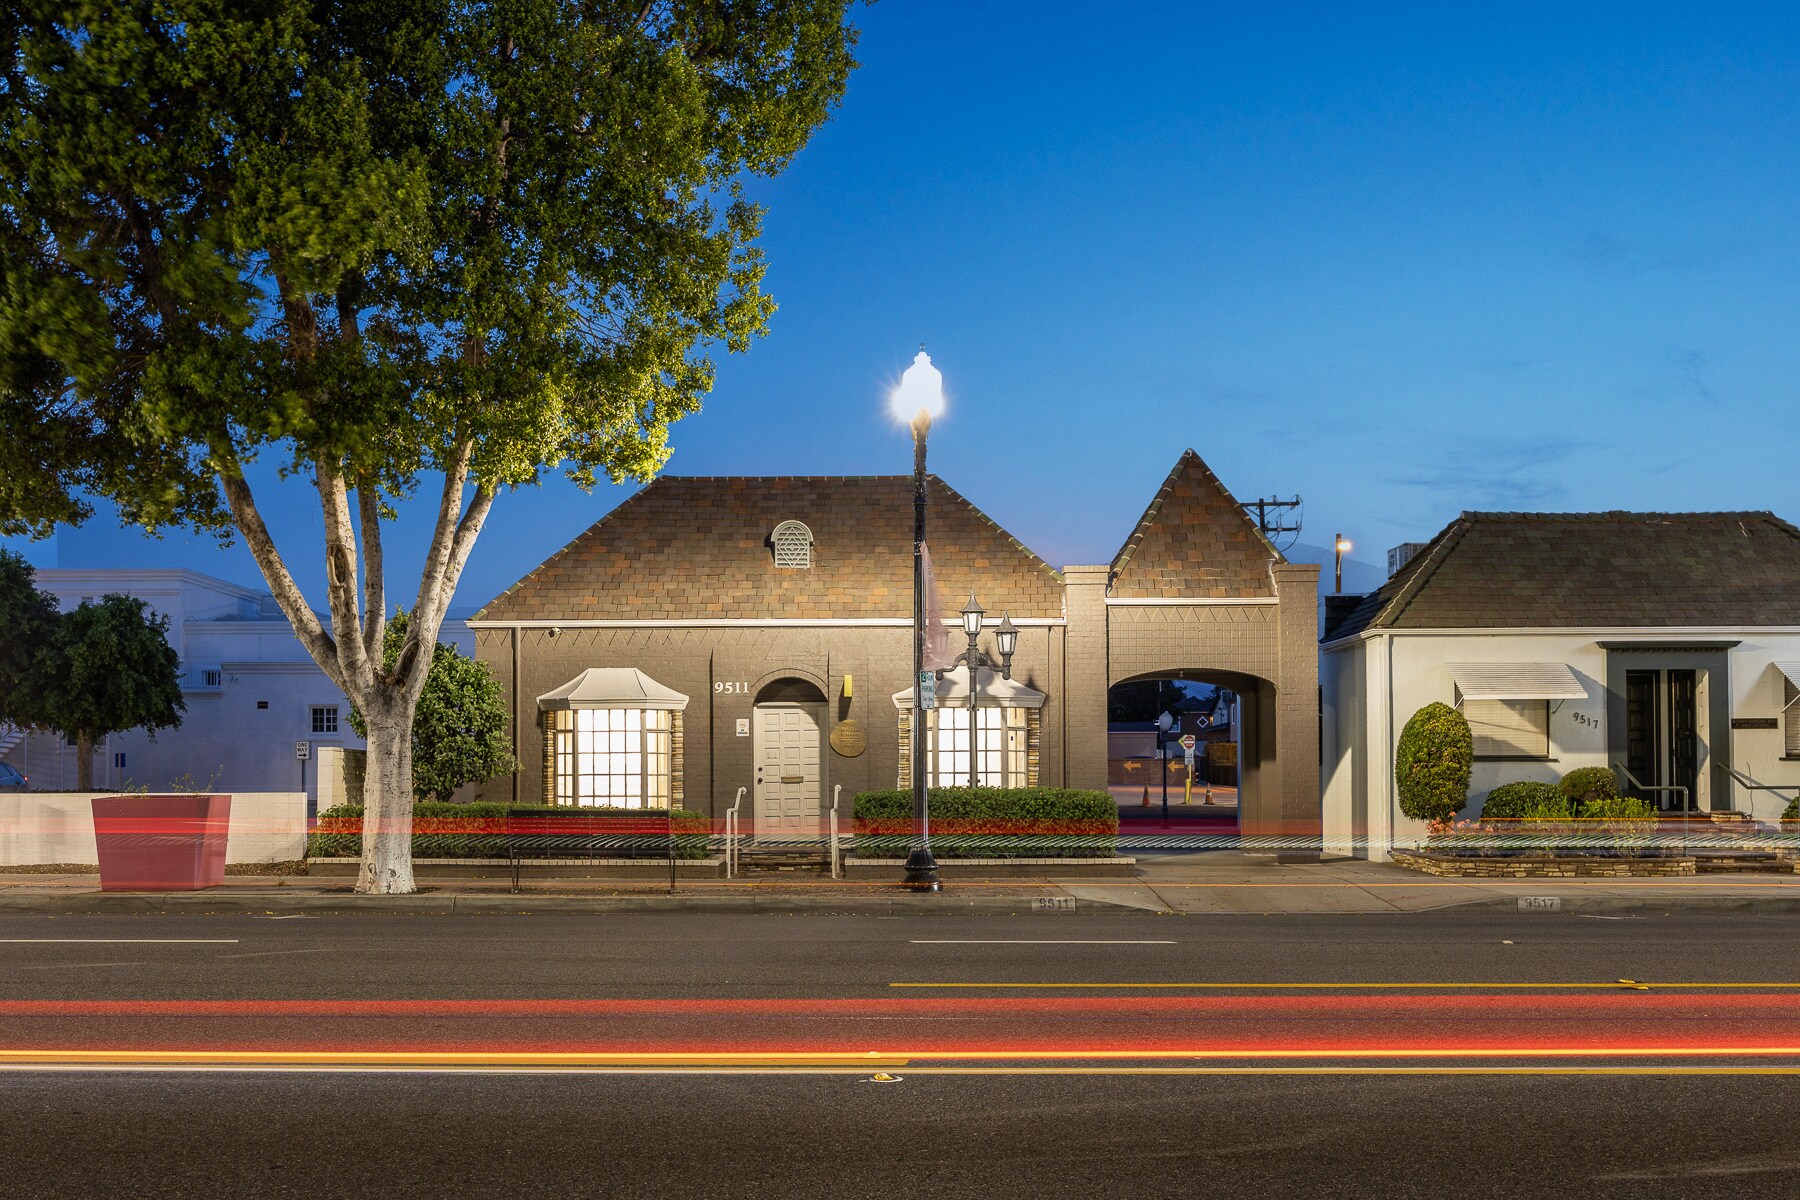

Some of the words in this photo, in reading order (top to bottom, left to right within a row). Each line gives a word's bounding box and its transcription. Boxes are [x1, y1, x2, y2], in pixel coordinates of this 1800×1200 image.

[714, 681, 750, 694] 9511
[1573, 711, 1599, 729] 9517
[1039, 897, 1069, 909] 9511
[1525, 897, 1555, 909] 9517
